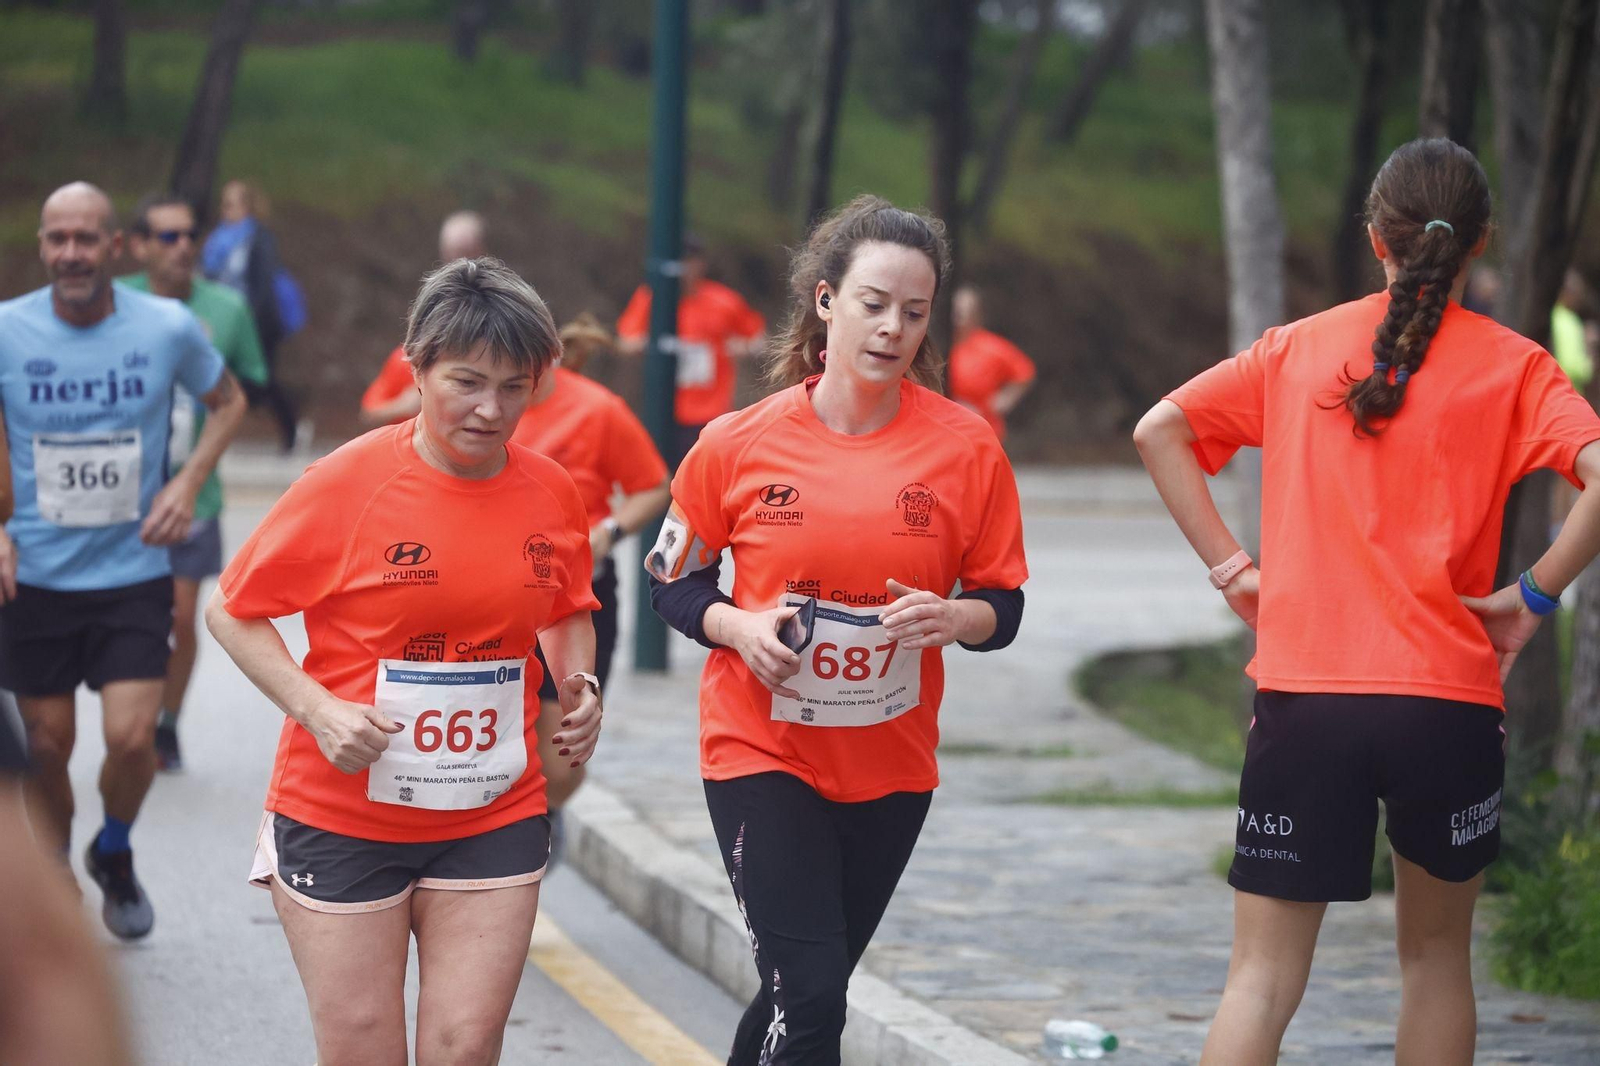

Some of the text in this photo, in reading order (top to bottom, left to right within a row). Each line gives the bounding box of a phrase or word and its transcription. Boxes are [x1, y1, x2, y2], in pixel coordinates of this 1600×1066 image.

[30, 370, 145, 405] nerja
[58, 461, 119, 490] 366
[755, 511, 803, 520] HYUNDAI
[383, 570, 438, 580] HYUNDAI
[831, 590, 887, 605] Ciudad
[812, 640, 898, 681] 687
[400, 673, 476, 684] www.deporte.malaga.eu
[822, 699, 856, 707] MARATÓN
[885, 686, 907, 700] BASTÓN
[414, 708, 497, 753] 663
[407, 775, 422, 783] MINI
[423, 775, 457, 784] MARATÓN
[458, 775, 476, 784] PEÑA
[486, 773, 510, 782] BASTÓN
[1246, 813, 1293, 836] A&D
[1260, 848, 1302, 862] DENTAL
